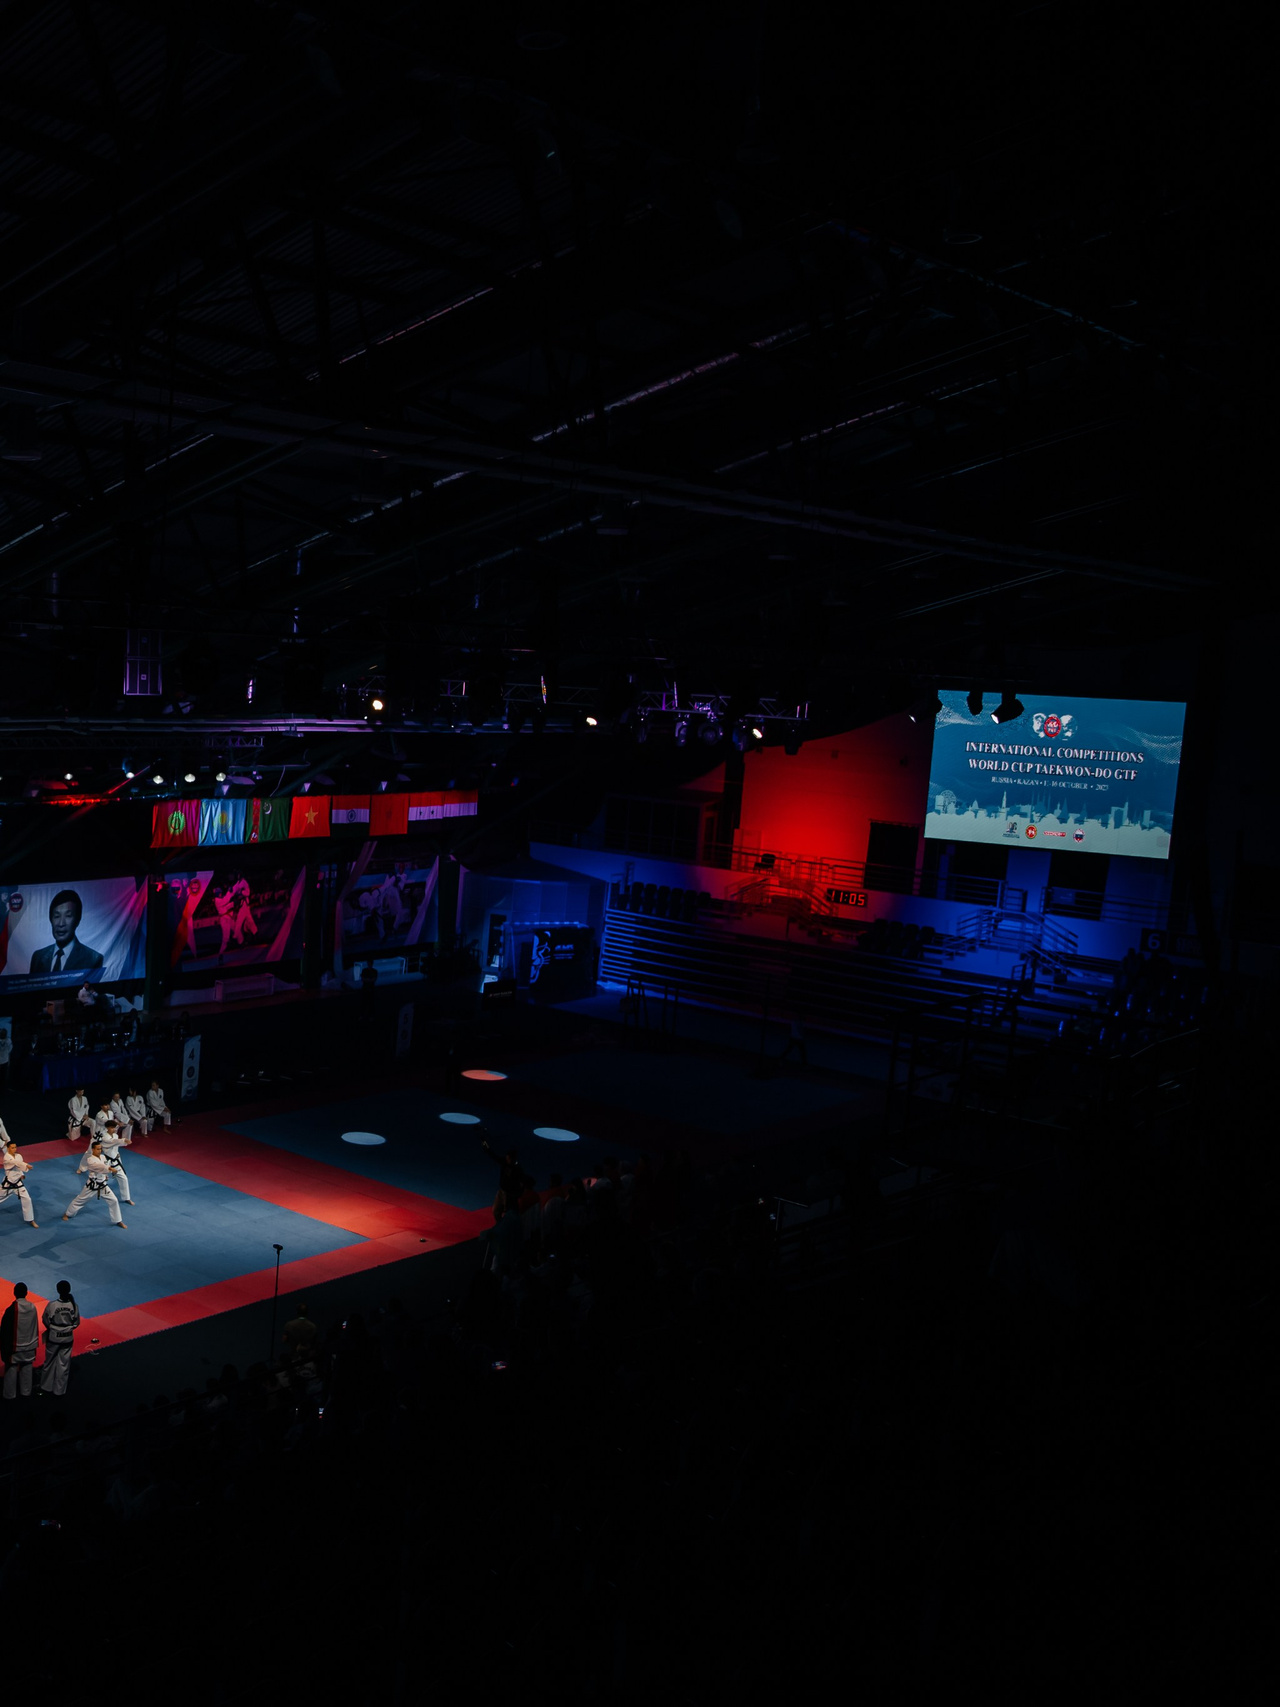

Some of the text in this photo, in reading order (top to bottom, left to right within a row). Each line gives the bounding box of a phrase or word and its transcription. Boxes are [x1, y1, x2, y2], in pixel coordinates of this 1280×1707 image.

[965, 741, 1144, 764] INTERNATIONAL COMPETITIONS
[968, 758, 1138, 780] WORLD CUP TAEKWON-DO GTF
[831, 889, 866, 906] 11:05
[1147, 932, 1161, 950] 6
[188, 1047, 196, 1062] 4
